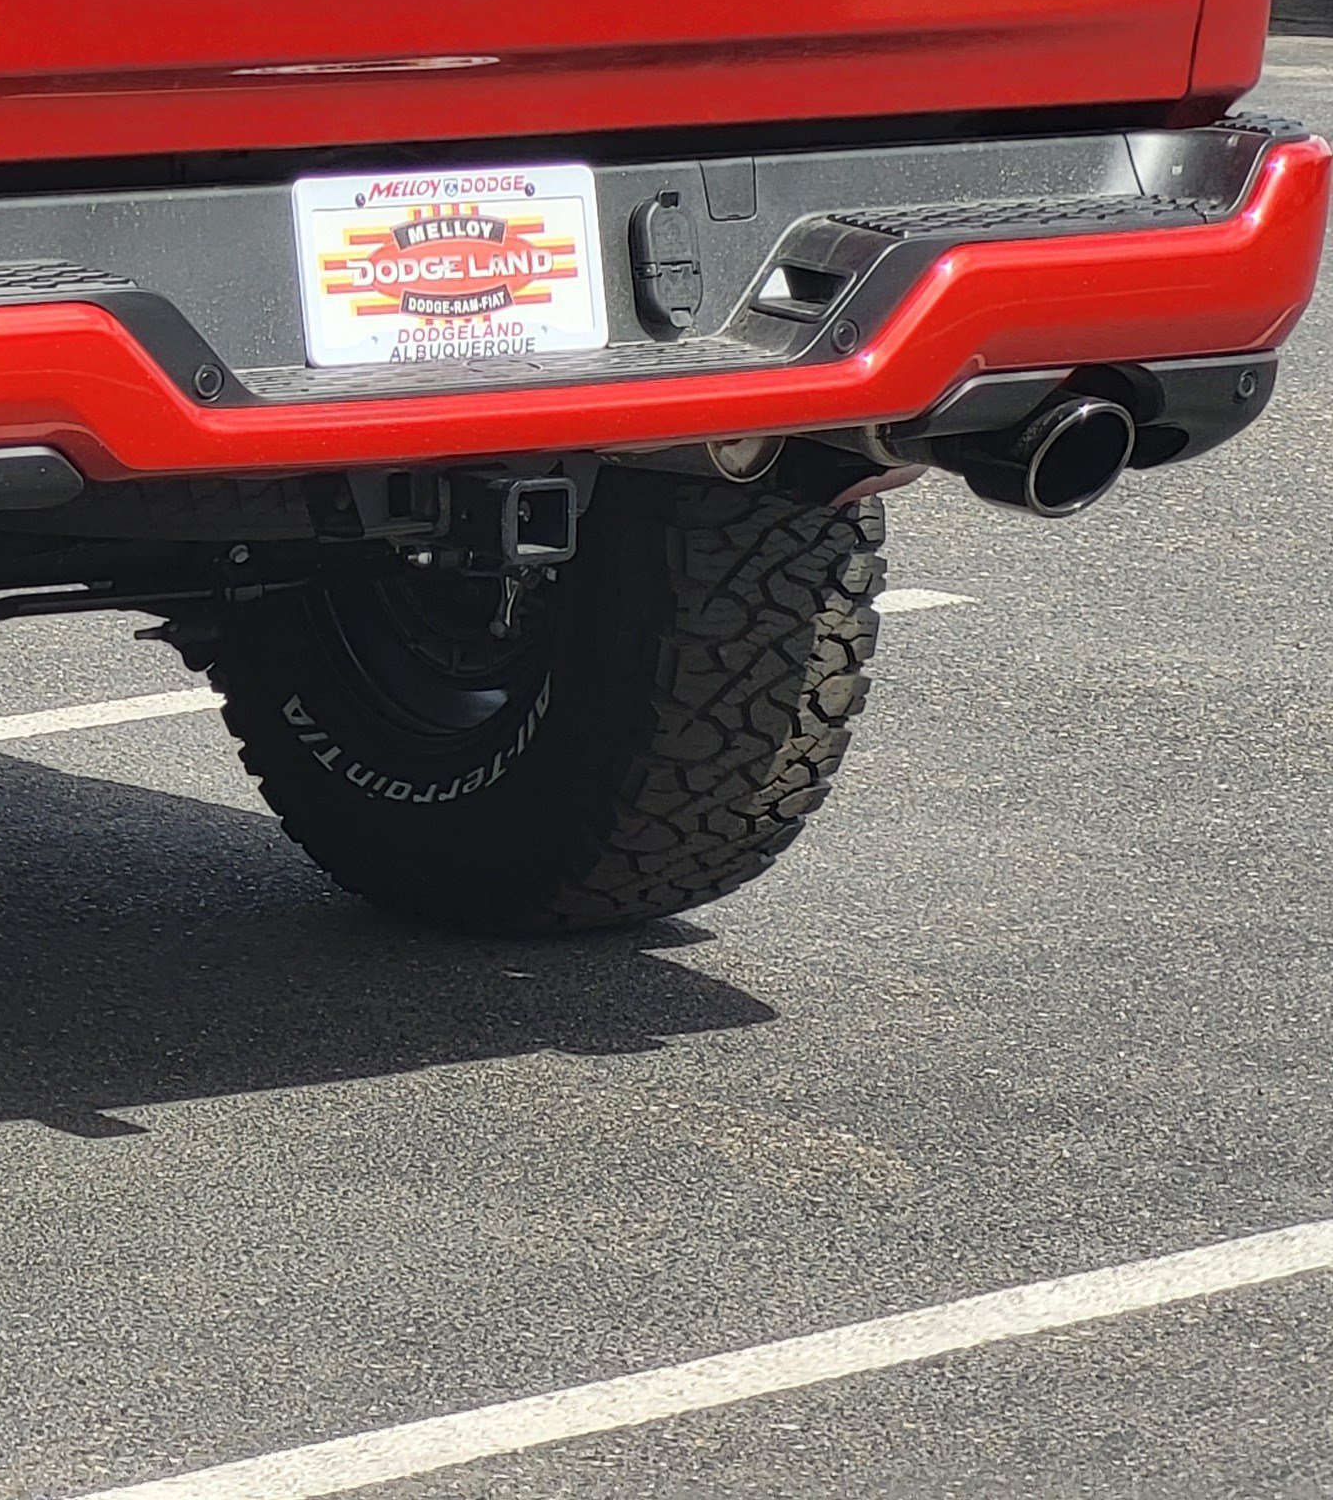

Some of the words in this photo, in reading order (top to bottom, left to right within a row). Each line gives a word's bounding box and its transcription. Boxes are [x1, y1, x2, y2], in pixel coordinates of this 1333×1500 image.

[461, 175, 525, 194] DODGE
[408, 219, 494, 245] MELLOY
[347, 255, 463, 287] DODGE
[469, 249, 554, 278] LAND
[397, 321, 524, 345] DODGELAND
[389, 337, 536, 365] ALBUQUERQUE
[345, 671, 552, 804] All-Terrain
